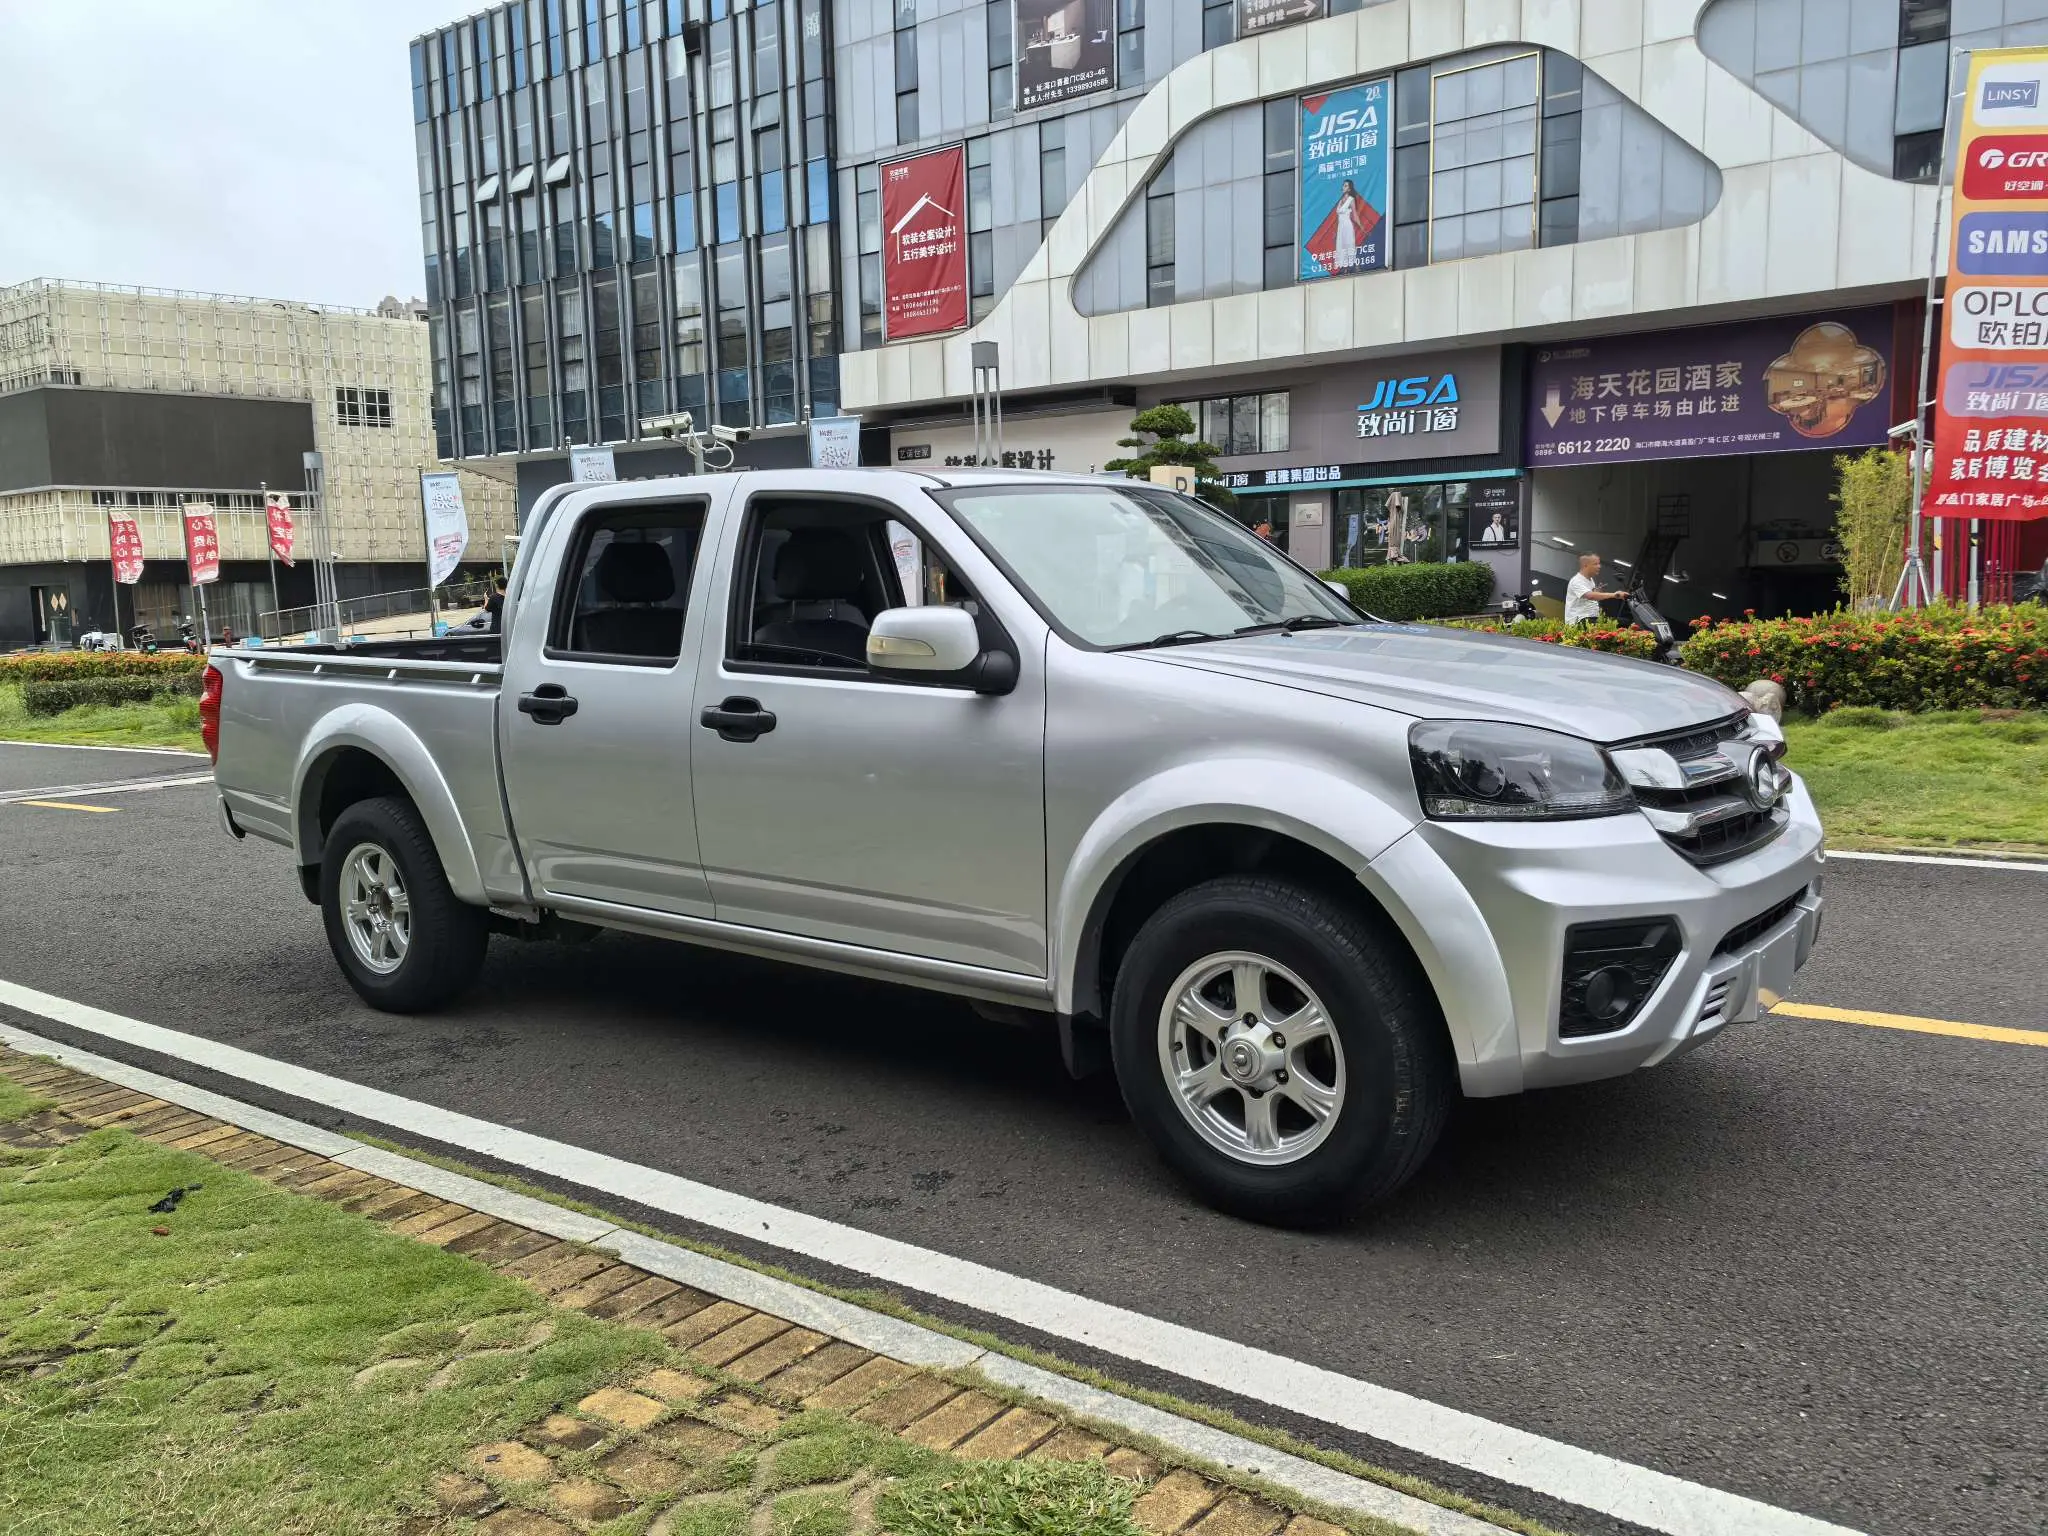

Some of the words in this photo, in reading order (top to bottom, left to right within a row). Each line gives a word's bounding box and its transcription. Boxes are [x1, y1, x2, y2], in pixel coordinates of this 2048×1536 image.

[1988, 88, 2032, 102] LINSY
[1308, 105, 1377, 140] JISA
[1308, 129, 1378, 160] 致尚门窗
[902, 241, 957, 262] 五行美学设计!
[1968, 229, 2048, 254] SAMS
[1978, 321, 2048, 346] 欧铂
[1357, 373, 1459, 412] JISA
[1570, 361, 1743, 400] 海天花园酒家
[1357, 406, 1459, 439] 致尚门窗
[1569, 394, 1741, 424] 地下停车场由此进
[1558, 440, 1592, 455] 6612
[1595, 437, 1631, 452] 2220
